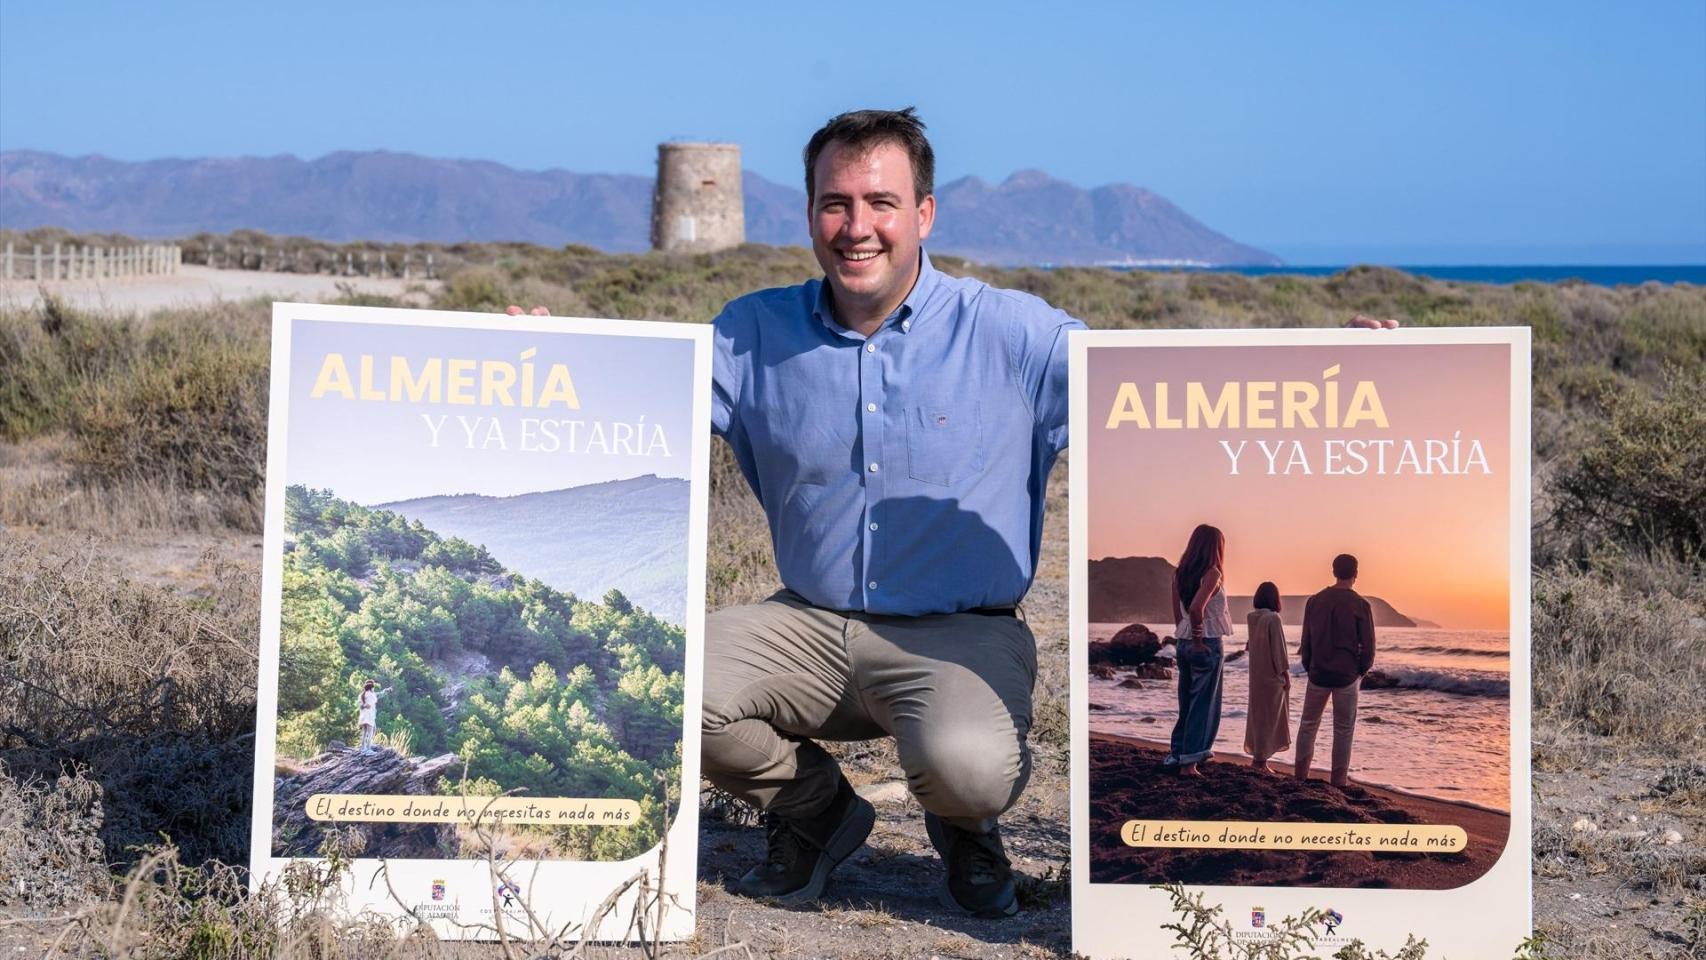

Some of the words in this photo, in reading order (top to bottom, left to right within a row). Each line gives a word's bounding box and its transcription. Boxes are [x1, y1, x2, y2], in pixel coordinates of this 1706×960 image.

[311, 347, 580, 410] ALMERÍA
[1105, 363, 1390, 429] ALMERÍA
[421, 414, 448, 448] Y
[456, 415, 510, 451] YA
[520, 415, 673, 458] ESTARÍA
[1219, 440, 1248, 475] Y
[1256, 440, 1313, 475] YA
[1323, 430, 1493, 475] ESTARÍA
[316, 797, 331, 816] El
[338, 800, 395, 816] destino
[403, 801, 449, 818] donde
[457, 808, 476, 819] no
[483, 803, 551, 820] necesitas
[558, 803, 595, 820] nada
[603, 808, 631, 820] más
[1131, 824, 1146, 842] El
[1153, 826, 1211, 843] destino
[1218, 827, 1265, 844] donde
[1274, 834, 1293, 844] no
[1301, 830, 1372, 846] necesitas
[1379, 830, 1418, 846] nada
[1426, 834, 1457, 847] más
